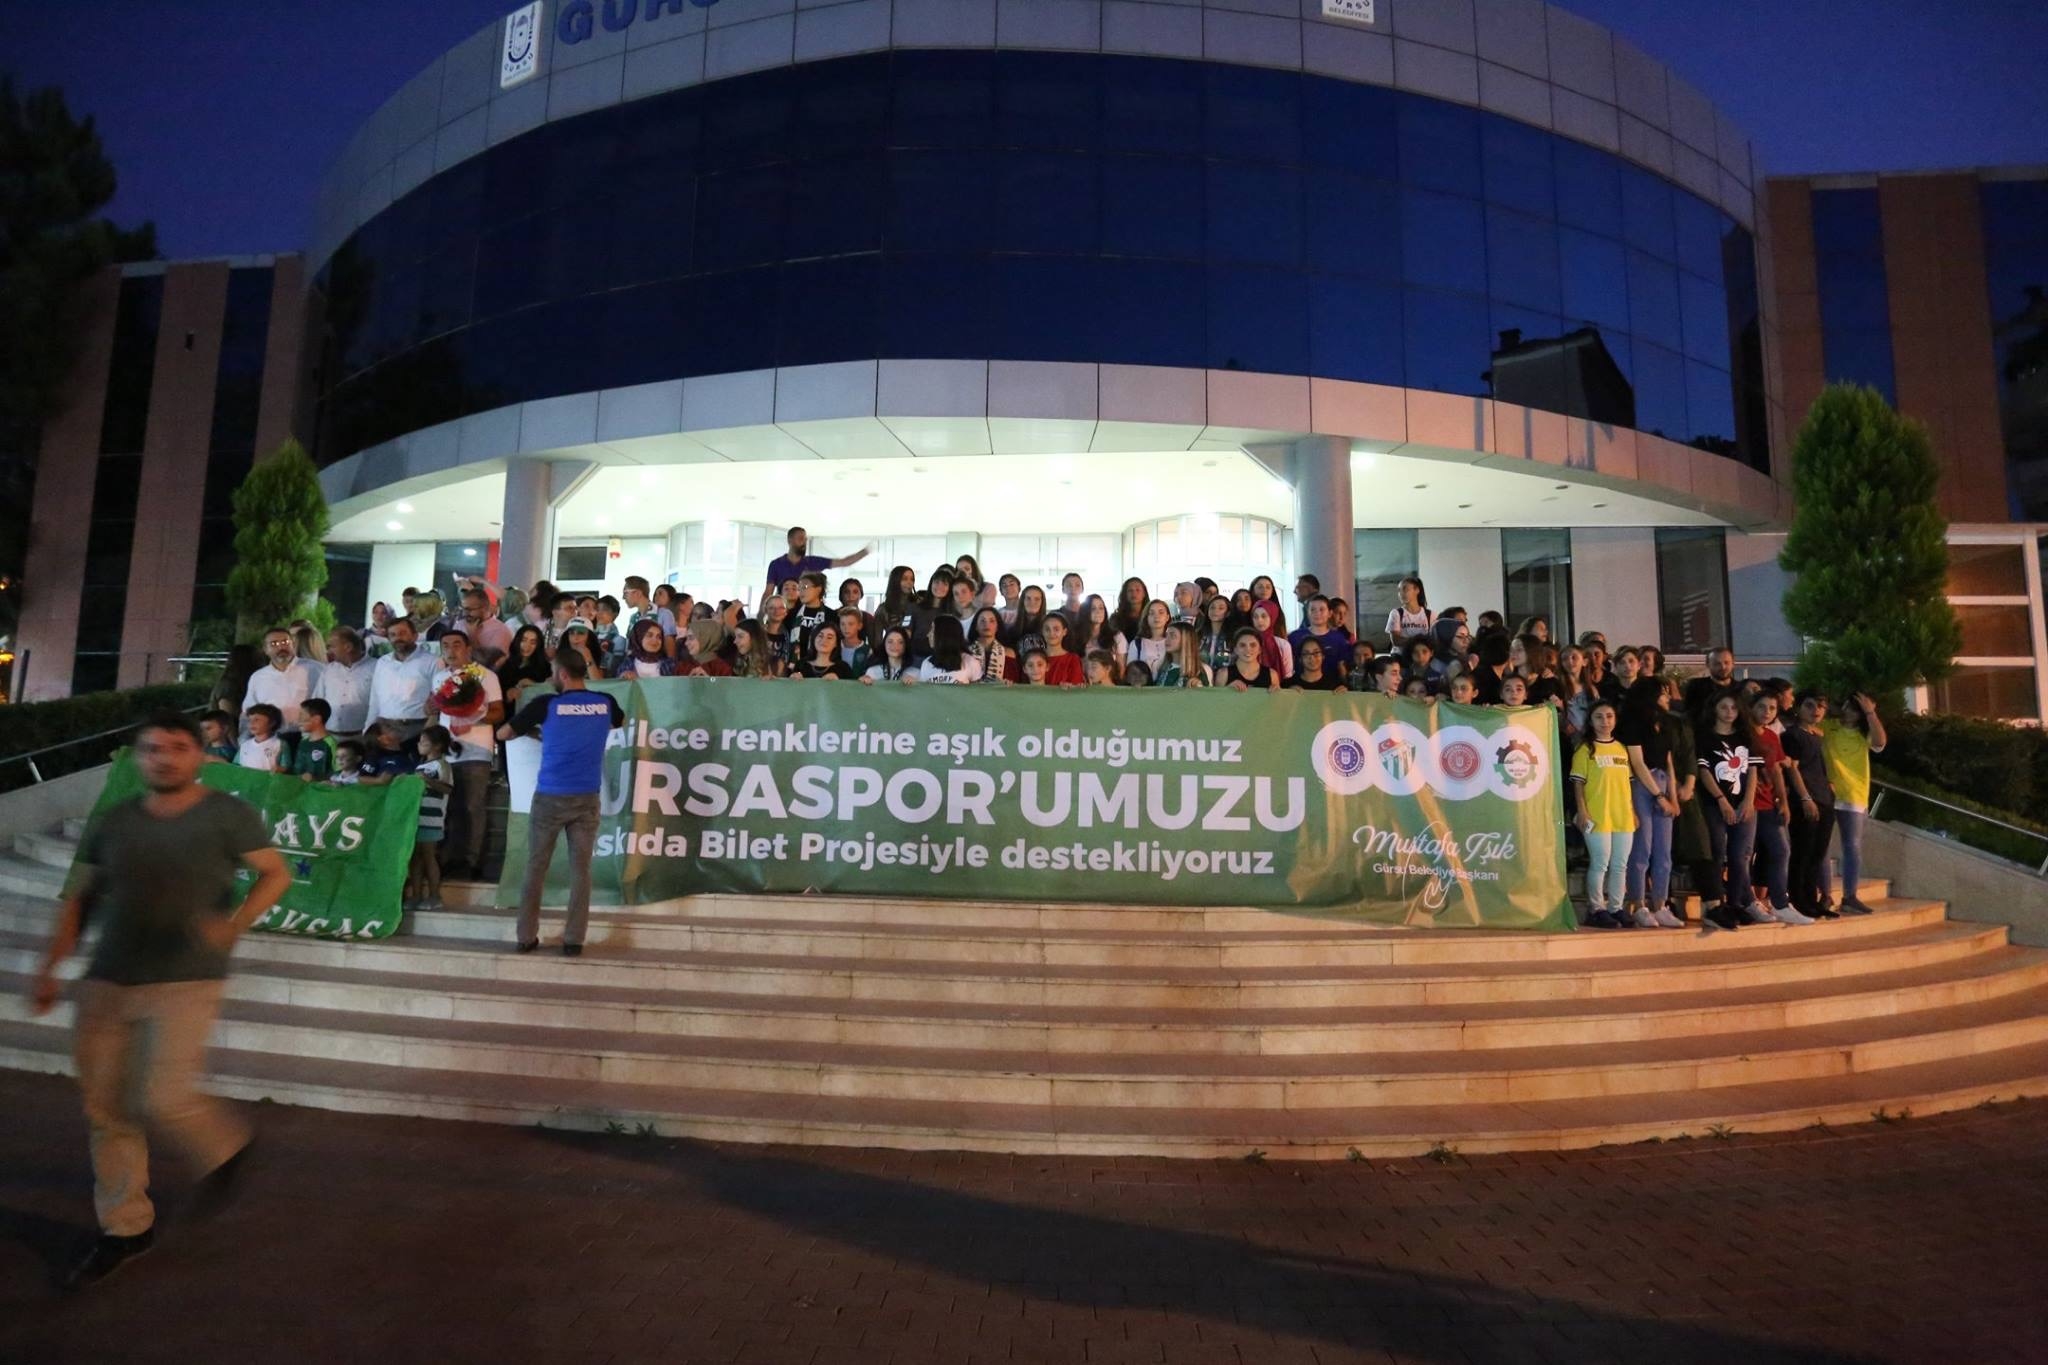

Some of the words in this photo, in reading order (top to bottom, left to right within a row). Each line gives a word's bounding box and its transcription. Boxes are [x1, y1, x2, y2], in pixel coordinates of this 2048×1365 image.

[605, 718, 709, 750] Ailece
[721, 723, 916, 754] renklerine
[926, 727, 1007, 765] aşık
[1017, 728, 1242, 767] olduğumuz
[600, 759, 1306, 833] URSASPOR'UMUZU
[592, 826, 688, 858] skıda
[700, 829, 788, 860] Bilet
[800, 831, 989, 873] Projesiyle
[1001, 838, 1275, 881] destekliyoruz
[1352, 825, 1460, 864] Mustafa
